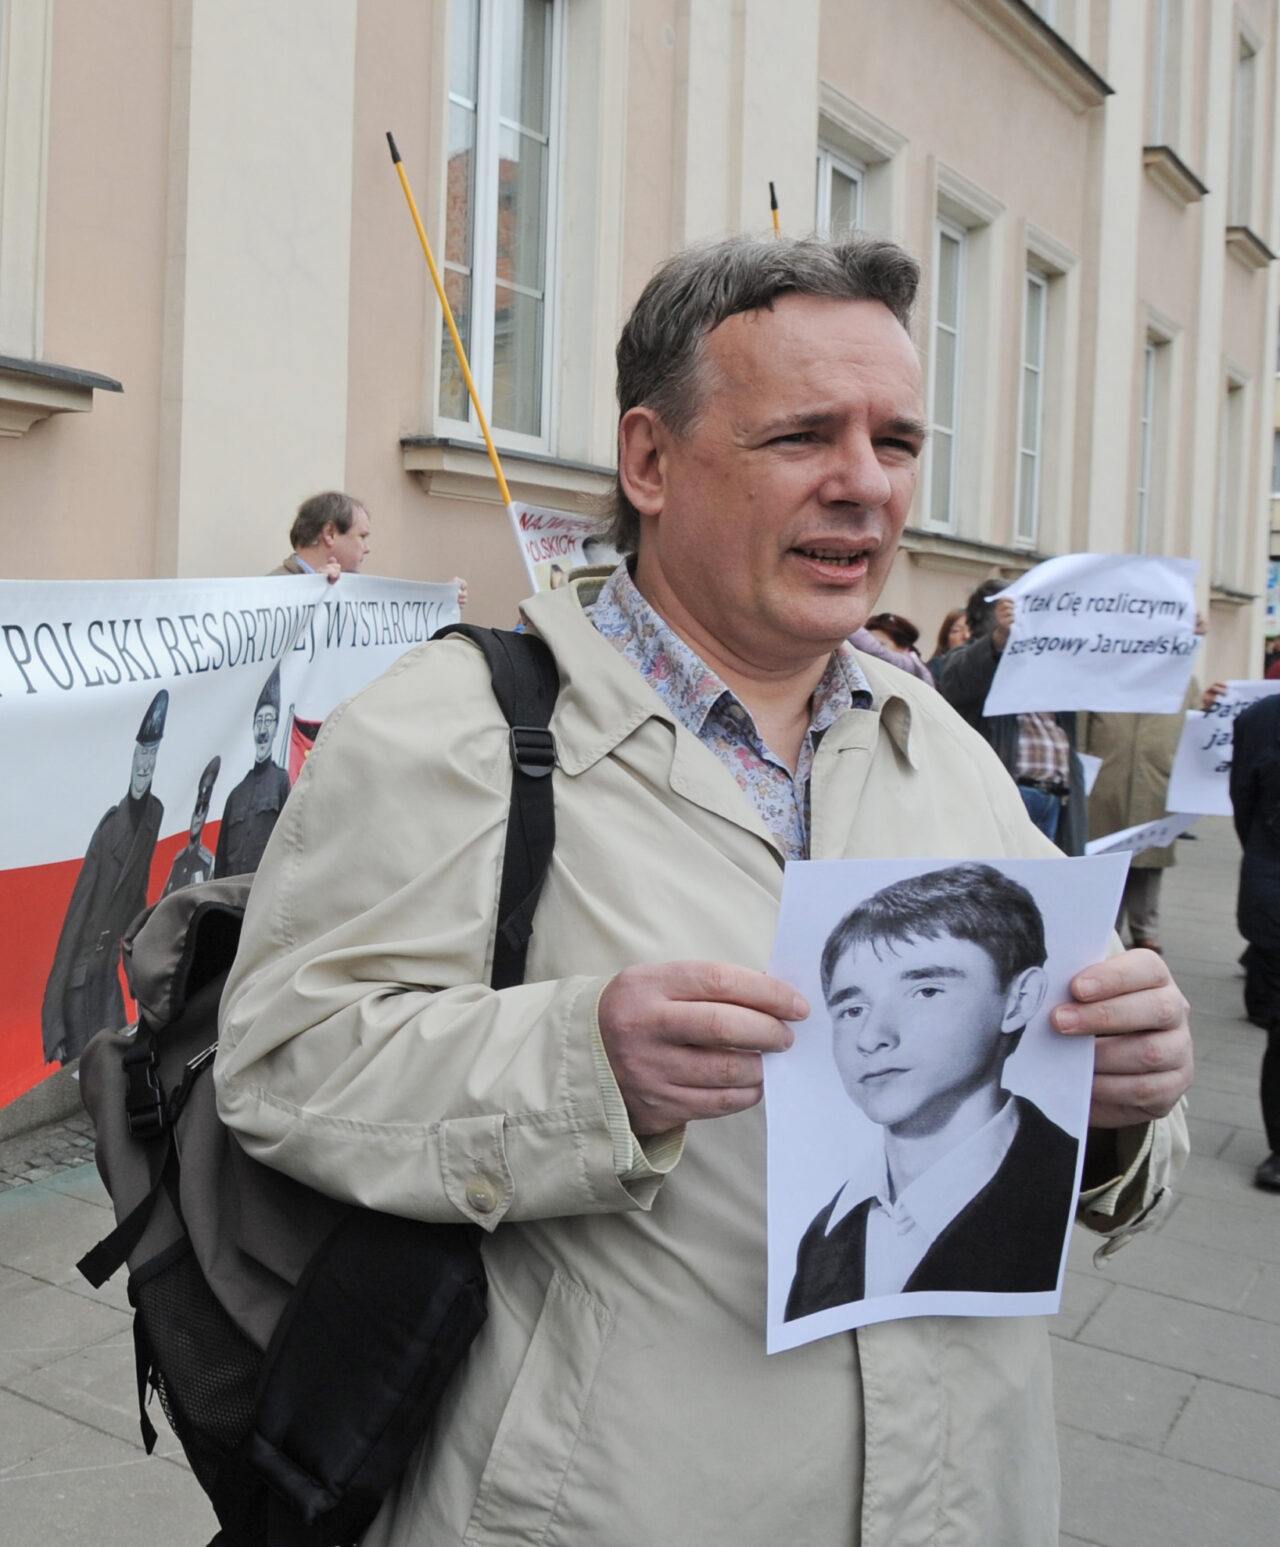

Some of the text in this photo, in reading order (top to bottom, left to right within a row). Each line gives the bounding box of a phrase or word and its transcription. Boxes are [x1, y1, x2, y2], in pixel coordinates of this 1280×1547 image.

[1057, 592, 1083, 616] Cię
[1087, 593, 1188, 620] rozliczymy
[2, 619, 162, 694] POLSKI
[158, 603, 316, 677] RESORTOWEJ
[324, 600, 436, 648] WYSTARCZY
